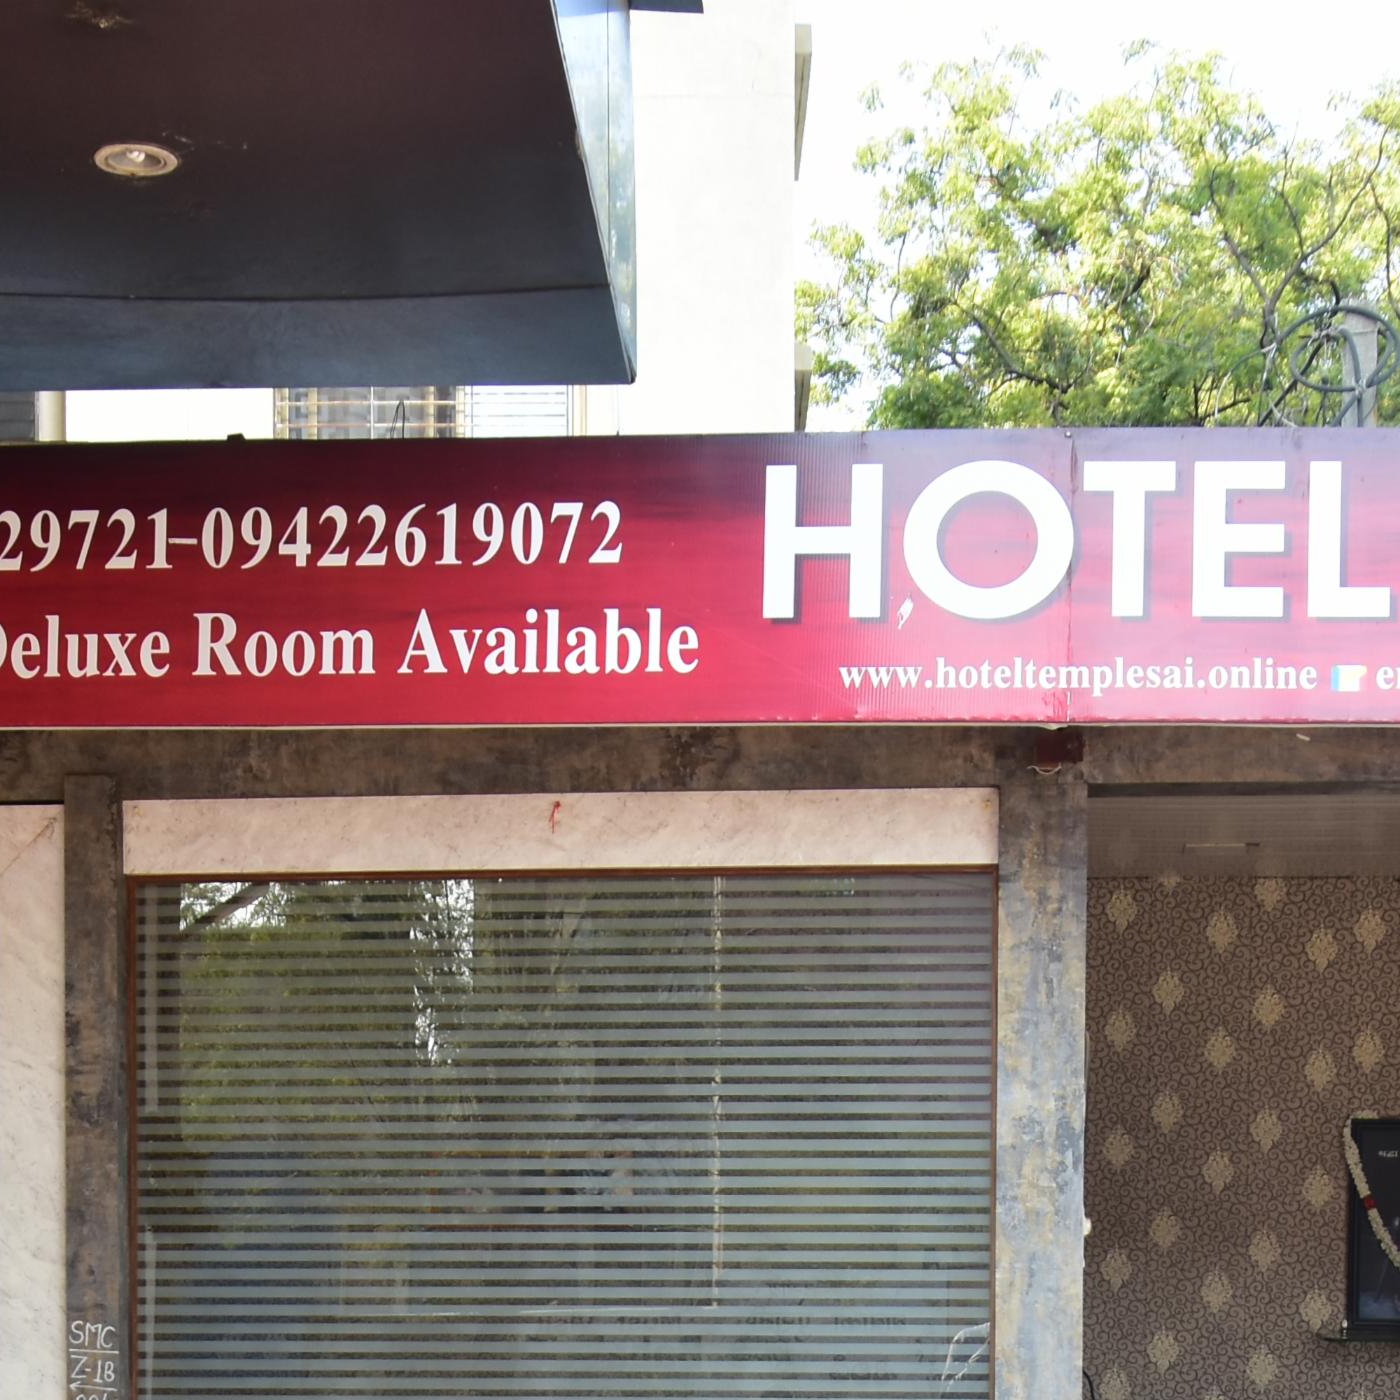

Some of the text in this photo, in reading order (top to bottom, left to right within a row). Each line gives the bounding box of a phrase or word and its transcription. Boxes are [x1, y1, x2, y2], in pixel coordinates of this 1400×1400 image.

[761, 459, 1392, 620] HOTEL
[191, 611, 377, 678] Room
[396, 606, 701, 676] Available
[839, 656, 1318, 697] www.hoteltemplesai.online
[69, 1320, 117, 1349] SMC
